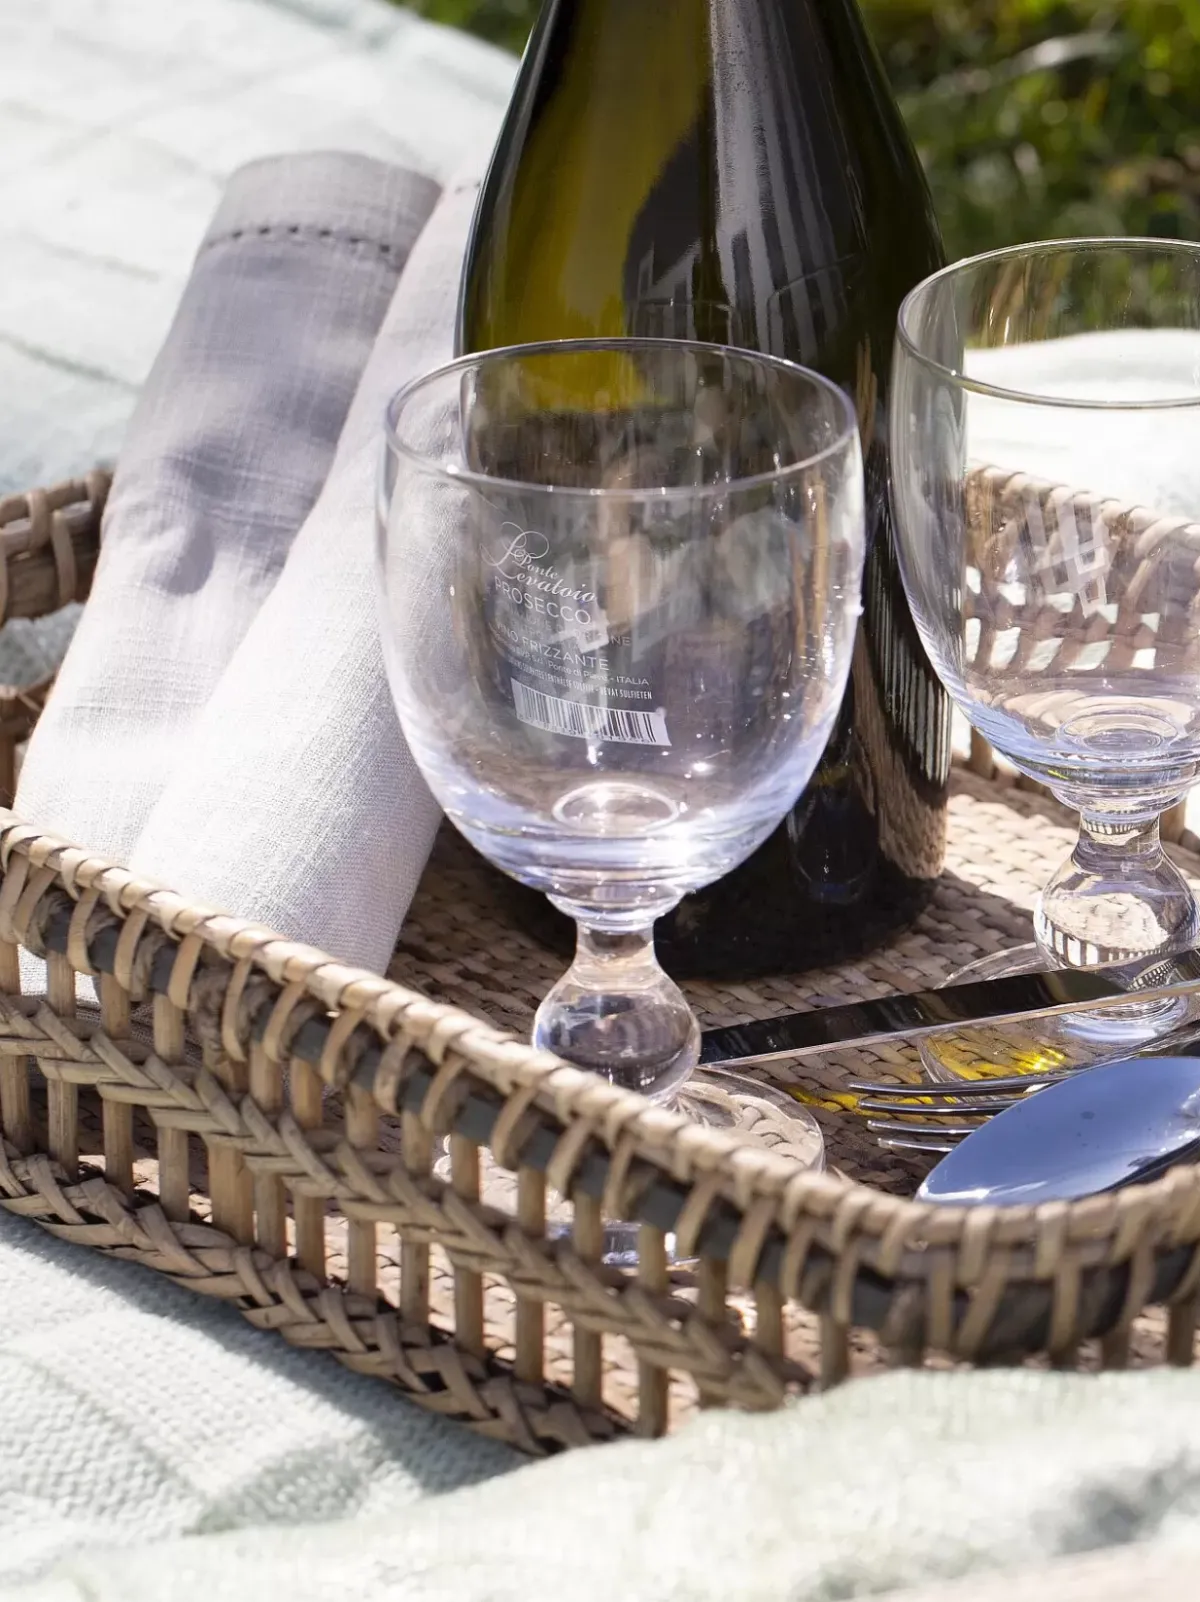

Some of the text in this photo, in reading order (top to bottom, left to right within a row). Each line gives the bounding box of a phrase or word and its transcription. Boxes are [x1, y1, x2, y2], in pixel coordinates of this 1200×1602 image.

[494, 575, 592, 625] PROSECCO
[522, 636, 610, 671] FRIZZANTE
[616, 675, 650, 686] ITALIA
[620, 689, 652, 700] SULFIETEN
